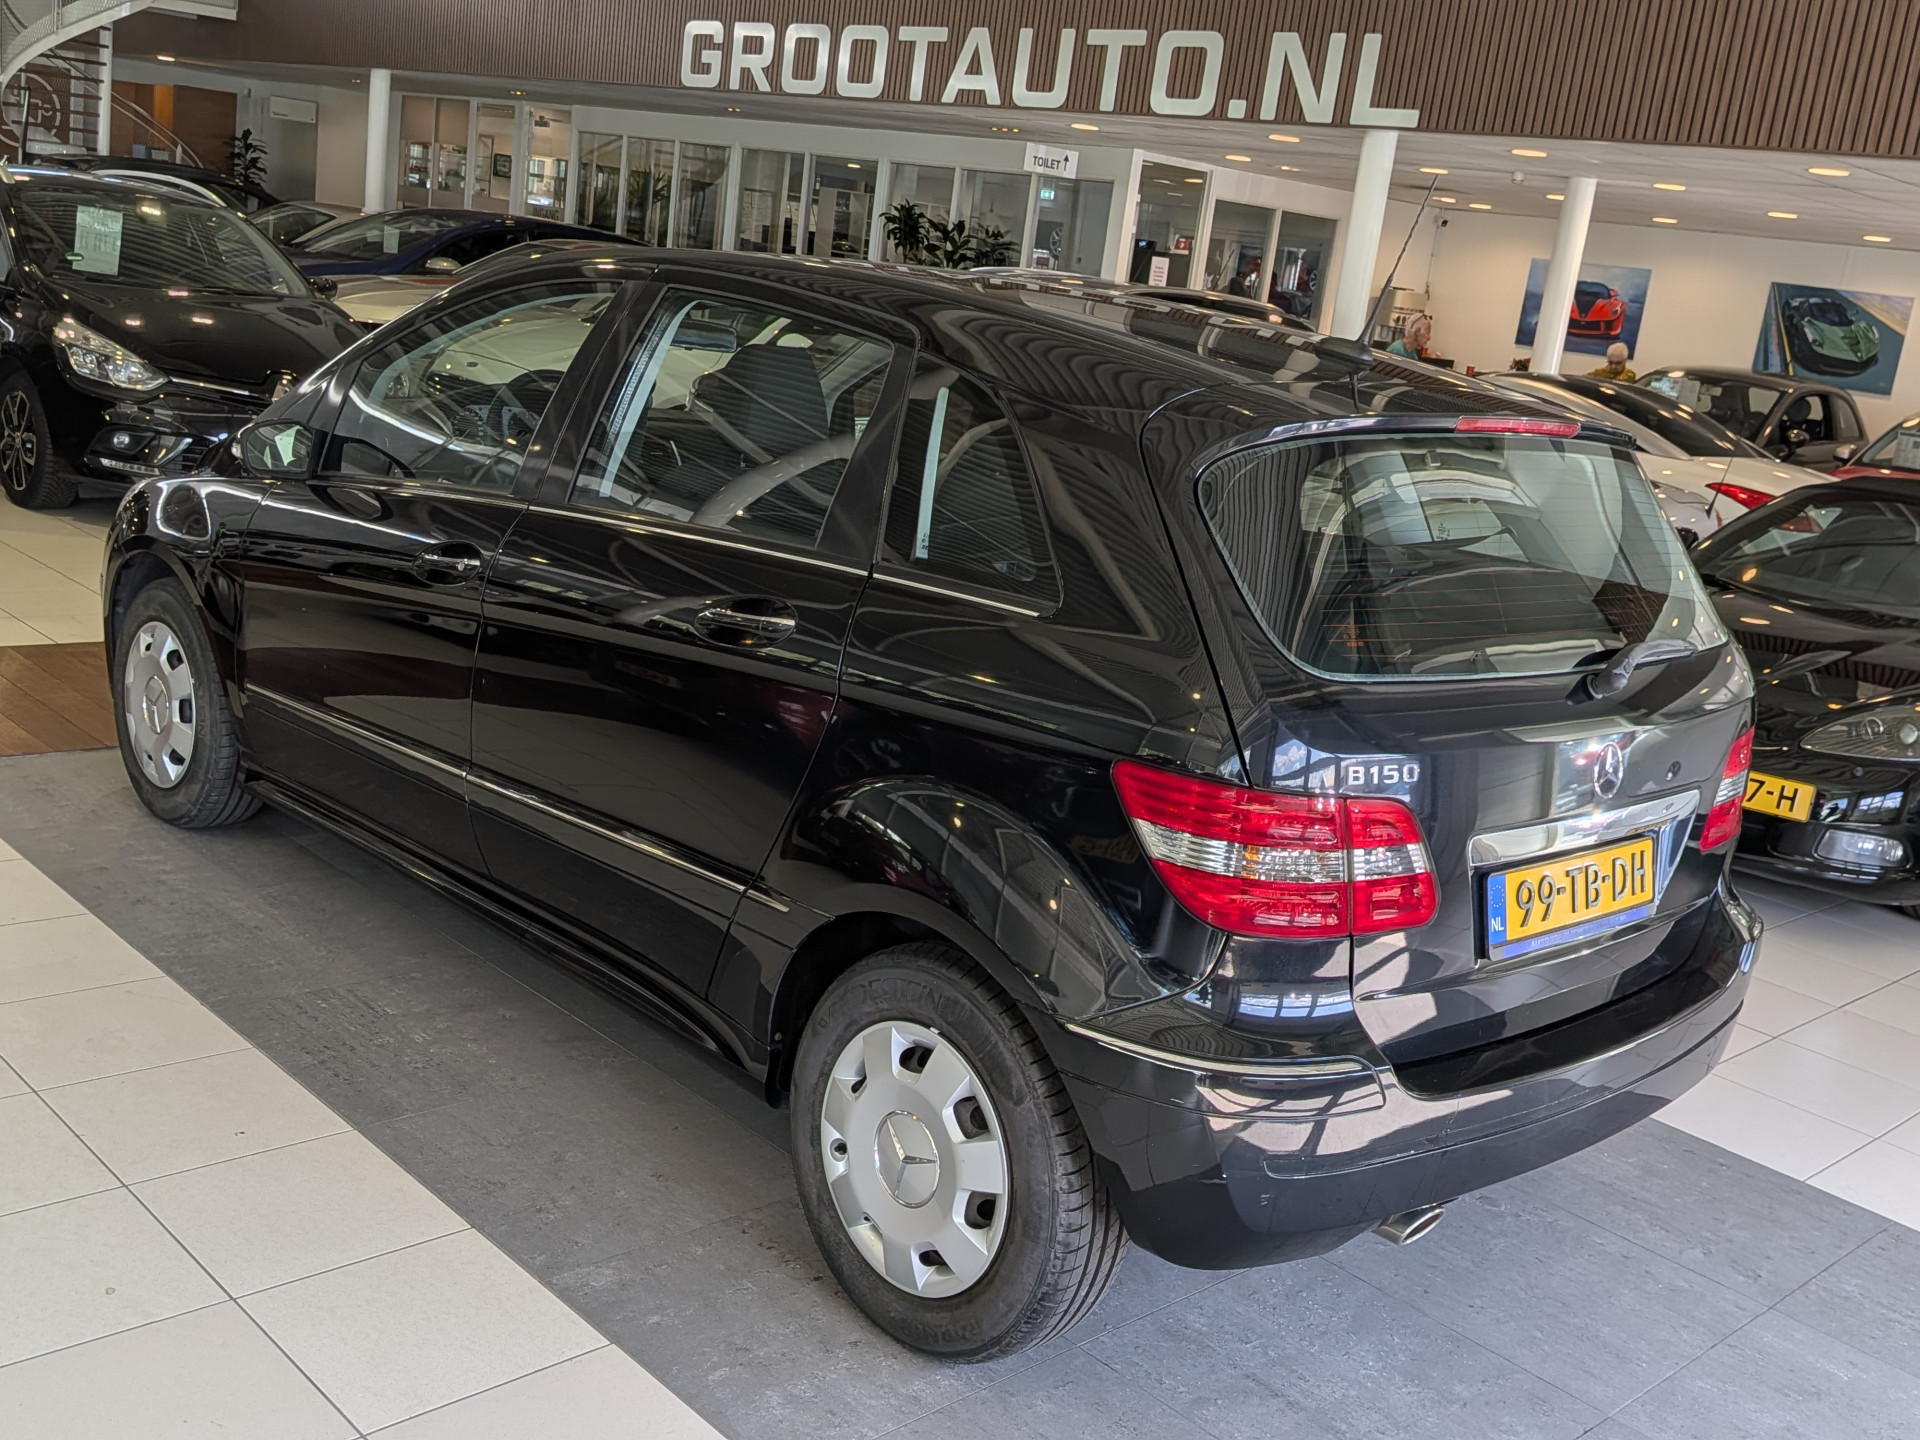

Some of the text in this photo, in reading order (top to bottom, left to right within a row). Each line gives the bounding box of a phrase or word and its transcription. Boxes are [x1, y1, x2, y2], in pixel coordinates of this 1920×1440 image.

[680, 20, 1420, 128] GROOTAUTO.NL
[1032, 155, 1061, 170] TOILET
[1348, 763, 1419, 785] B150
[1515, 849, 1647, 928] 99-TB-DH
[1491, 917, 1505, 933] NL
